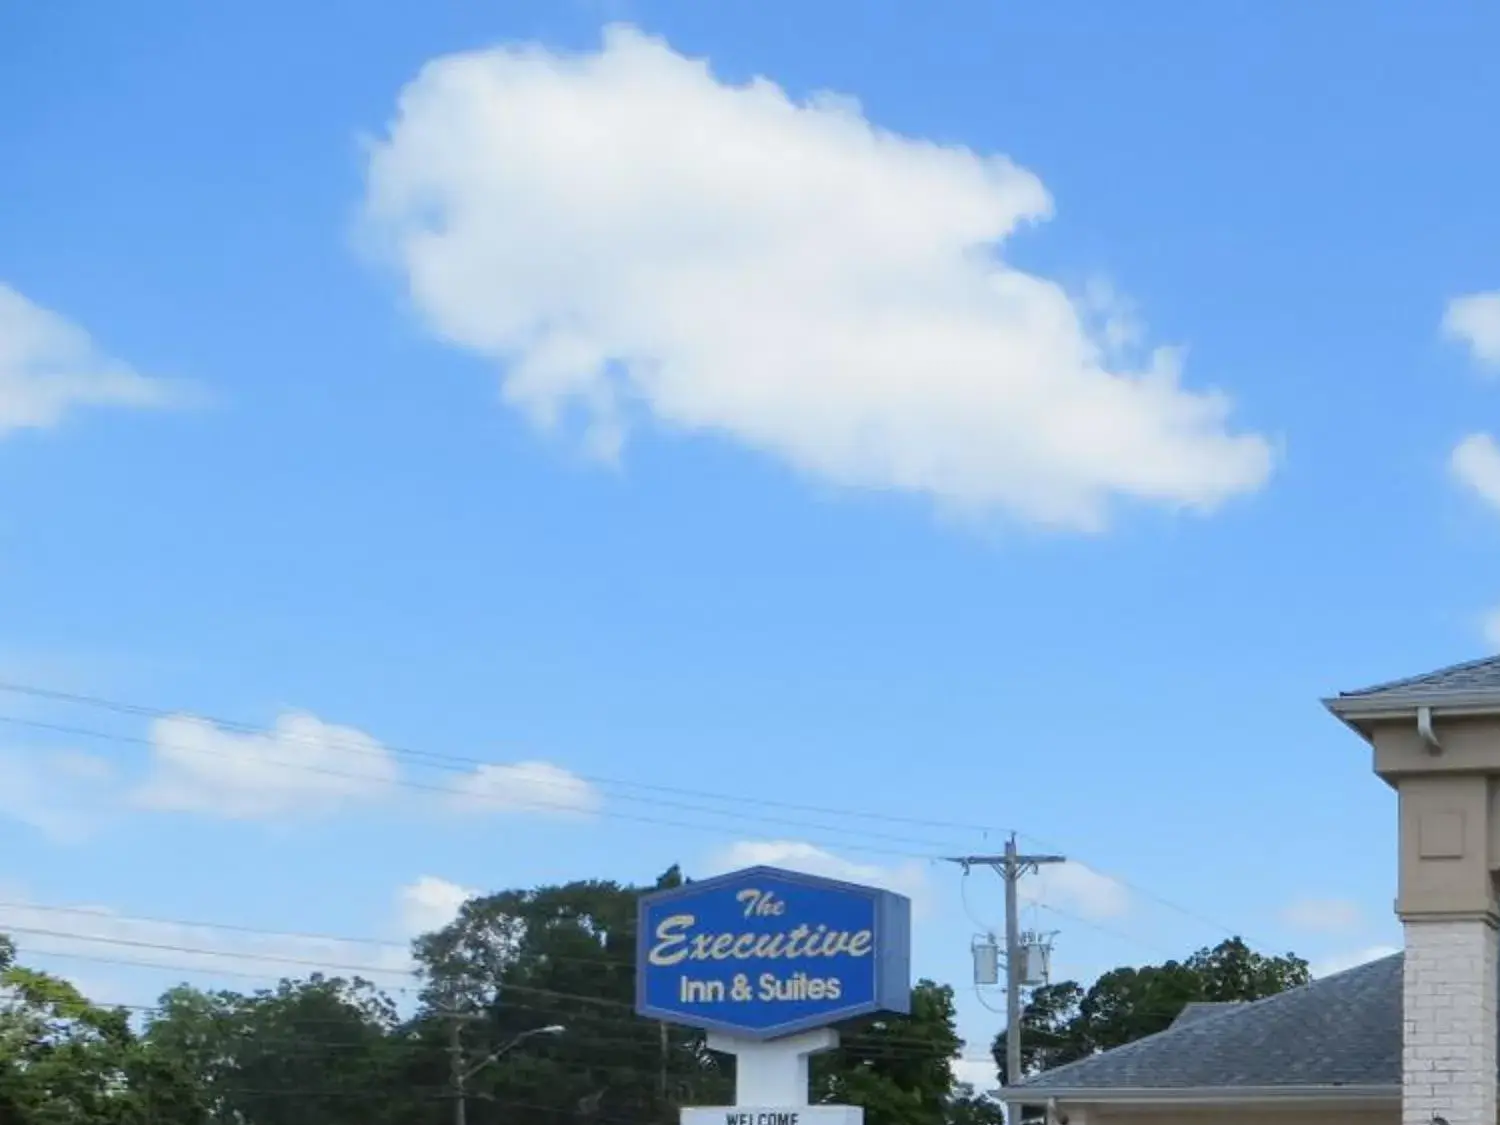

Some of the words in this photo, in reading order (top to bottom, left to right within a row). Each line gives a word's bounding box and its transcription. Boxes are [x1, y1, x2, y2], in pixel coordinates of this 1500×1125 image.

[736, 889, 785, 918] The
[650, 914, 872, 966] Executive
[680, 975, 724, 1002] Inn
[730, 973, 753, 1001] &
[758, 972, 841, 1001] Suites
